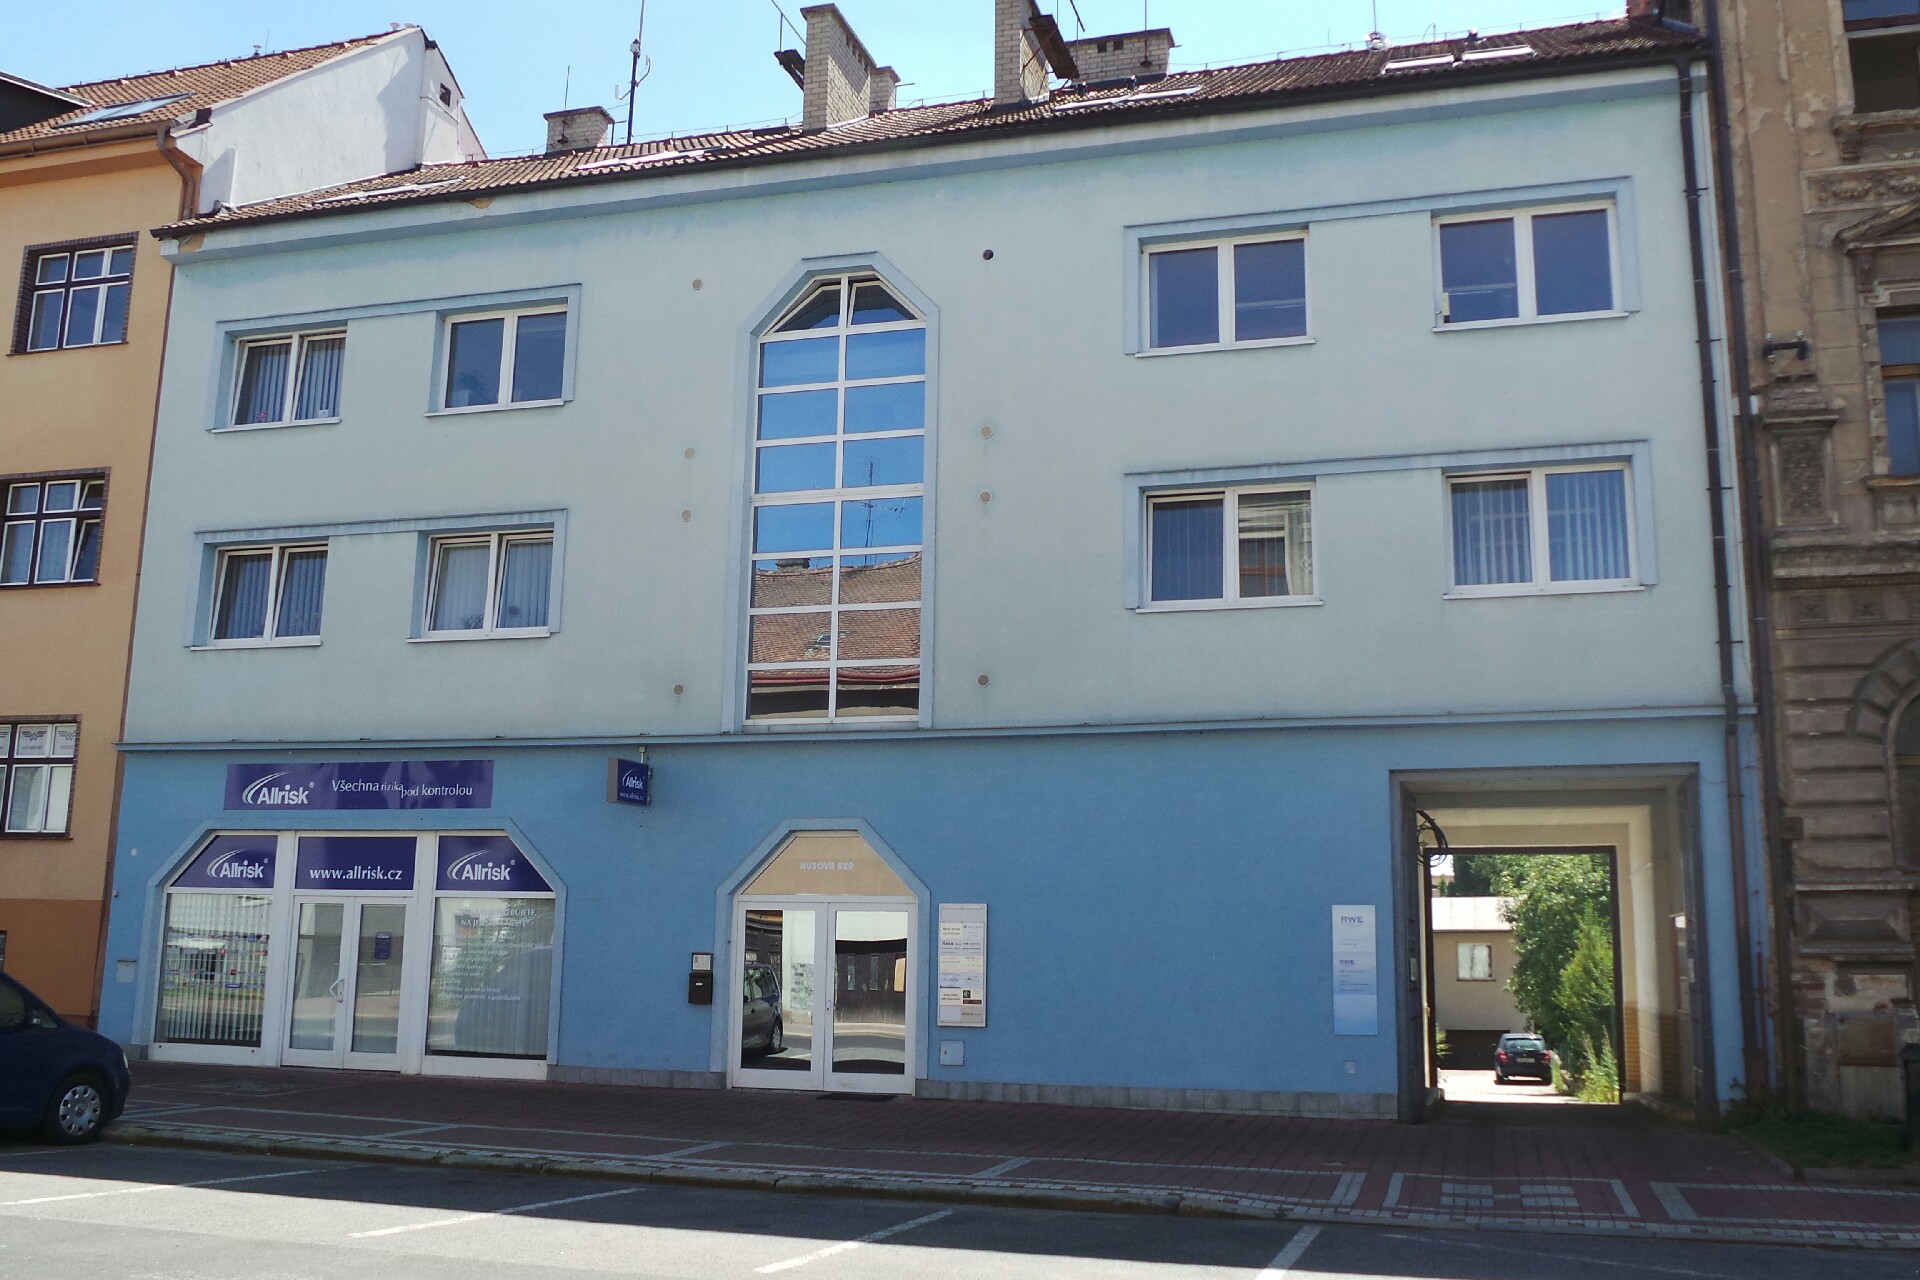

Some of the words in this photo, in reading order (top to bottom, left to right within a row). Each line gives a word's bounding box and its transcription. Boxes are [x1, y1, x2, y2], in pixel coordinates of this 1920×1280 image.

[331, 778, 378, 792] Všechna
[381, 783, 403, 791] rizika
[401, 787, 419, 798] pod
[421, 784, 473, 796] kontrolou
[626, 776, 643, 790] Allrisk
[257, 784, 308, 804] Allrisk
[219, 860, 264, 879] Allrisk
[309, 865, 403, 880] www.allrisk.cz
[461, 861, 511, 881] Allrisk
[1340, 915, 1364, 924] RWE
